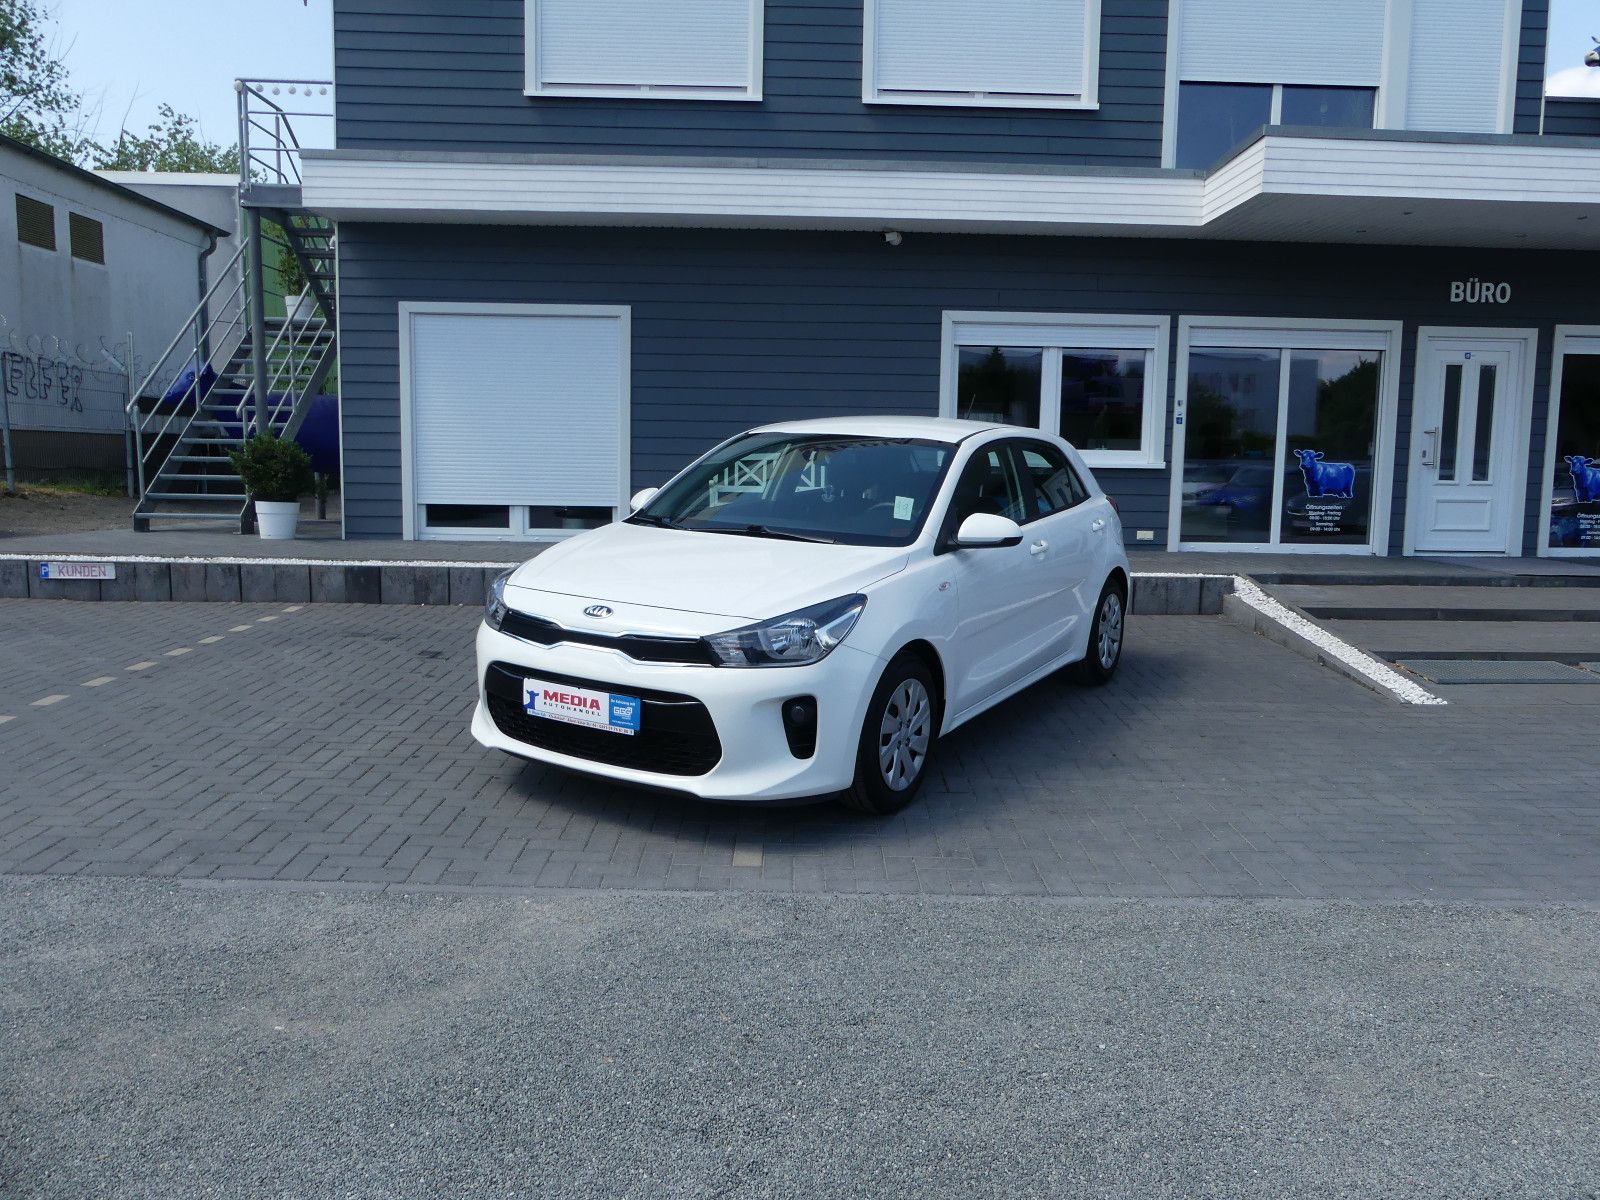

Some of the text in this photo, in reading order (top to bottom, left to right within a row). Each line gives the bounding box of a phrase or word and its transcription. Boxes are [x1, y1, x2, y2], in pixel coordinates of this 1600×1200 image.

[1449, 277, 1511, 304] BÜRO
[57, 564, 107, 577] KUNDEN
[585, 605, 611, 617] KIA
[543, 689, 601, 711] MEDIA
[543, 701, 601, 717] AUTOHANDEL
